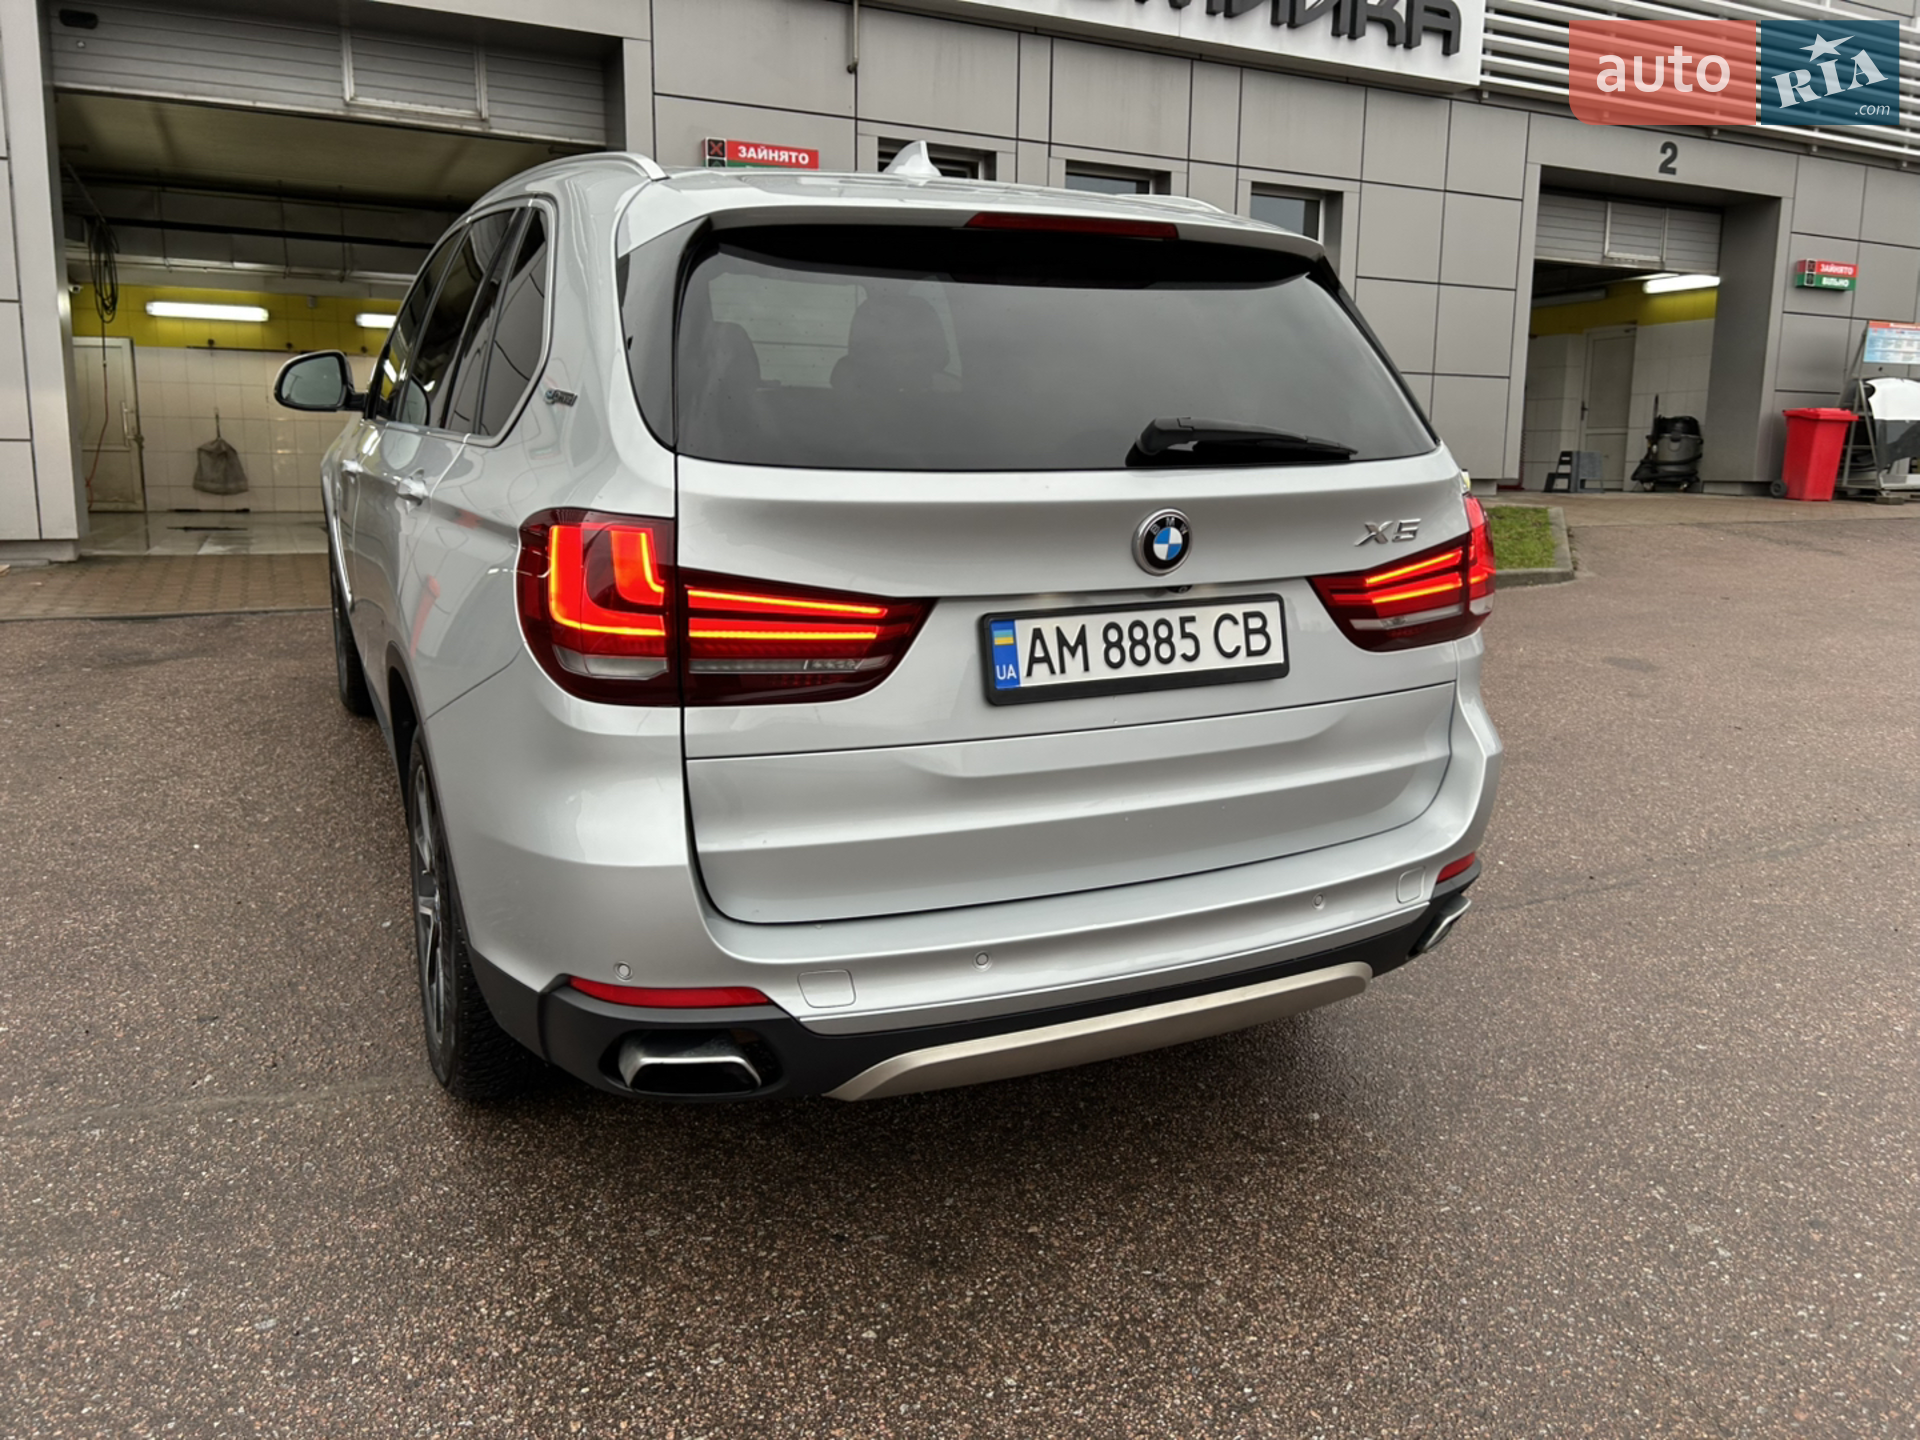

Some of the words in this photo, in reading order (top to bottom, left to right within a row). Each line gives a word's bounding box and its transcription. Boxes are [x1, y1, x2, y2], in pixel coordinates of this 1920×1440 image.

[738, 146, 809, 164] ЗАЙНЯТО
[1659, 141, 1678, 175] 2
[1150, 516, 1189, 536] BMW
[1354, 518, 1421, 547] X5
[1102, 616, 1201, 669] 8885
[995, 664, 1018, 681] UA
